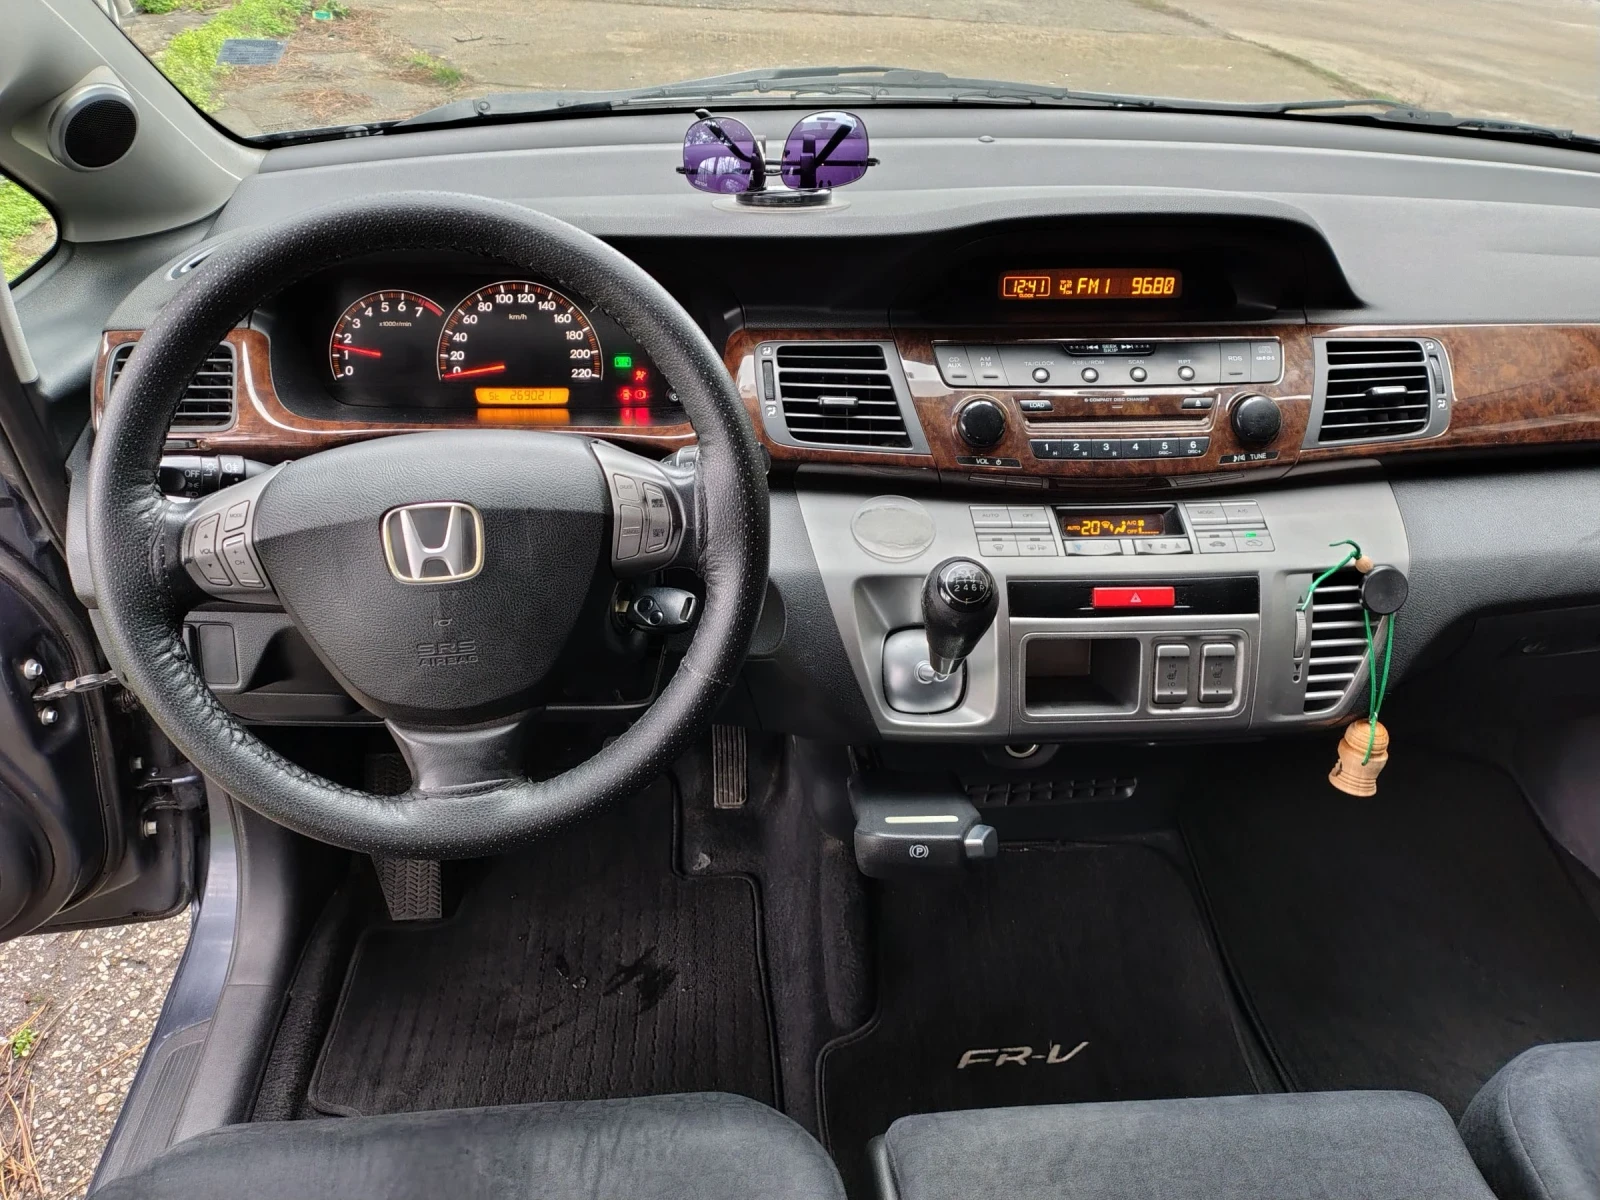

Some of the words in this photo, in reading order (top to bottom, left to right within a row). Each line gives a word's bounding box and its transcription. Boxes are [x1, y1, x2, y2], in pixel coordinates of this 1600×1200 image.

[1013, 279, 1045, 293] 12:41
[495, 293, 513, 304] 100
[517, 293, 535, 303] 120
[381, 301, 390, 313] 5
[397, 301, 407, 312] 6
[477, 301, 493, 312] 80
[538, 300, 556, 311] 140
[364, 306, 373, 317] 4
[415, 306, 423, 318] 7
[508, 313, 528, 321] km/h
[352, 318, 361, 329] 3
[462, 314, 478, 325] 60
[554, 313, 572, 324] 160
[343, 333, 353, 344] 2
[452, 332, 468, 343] 40
[566, 330, 584, 341] 180
[343, 350, 349, 360] 1
[449, 350, 465, 361] 20
[570, 349, 591, 359] 200
[344, 365, 354, 376] 0
[452, 366, 462, 375] 0
[571, 368, 592, 379] 220
[1029, 401, 1046, 409] LOAD
[1044, 443, 1050, 451] 1
[1073, 443, 1080, 451] 2
[1102, 443, 1110, 451] 3
[1132, 443, 1139, 451] 4
[1161, 442, 1169, 450] 5
[1190, 440, 1197, 449] 6
[1249, 452, 1267, 460] TUNE
[184, 469, 201, 478] OFF
[1081, 520, 1101, 535] 20
[953, 584, 961, 592] 2
[963, 583, 969, 591] 4
[971, 583, 978, 592] 6
[979, 584, 986, 592] R
[415, 640, 477, 655] SRS
[956, 1040, 1091, 1069] FR-V
